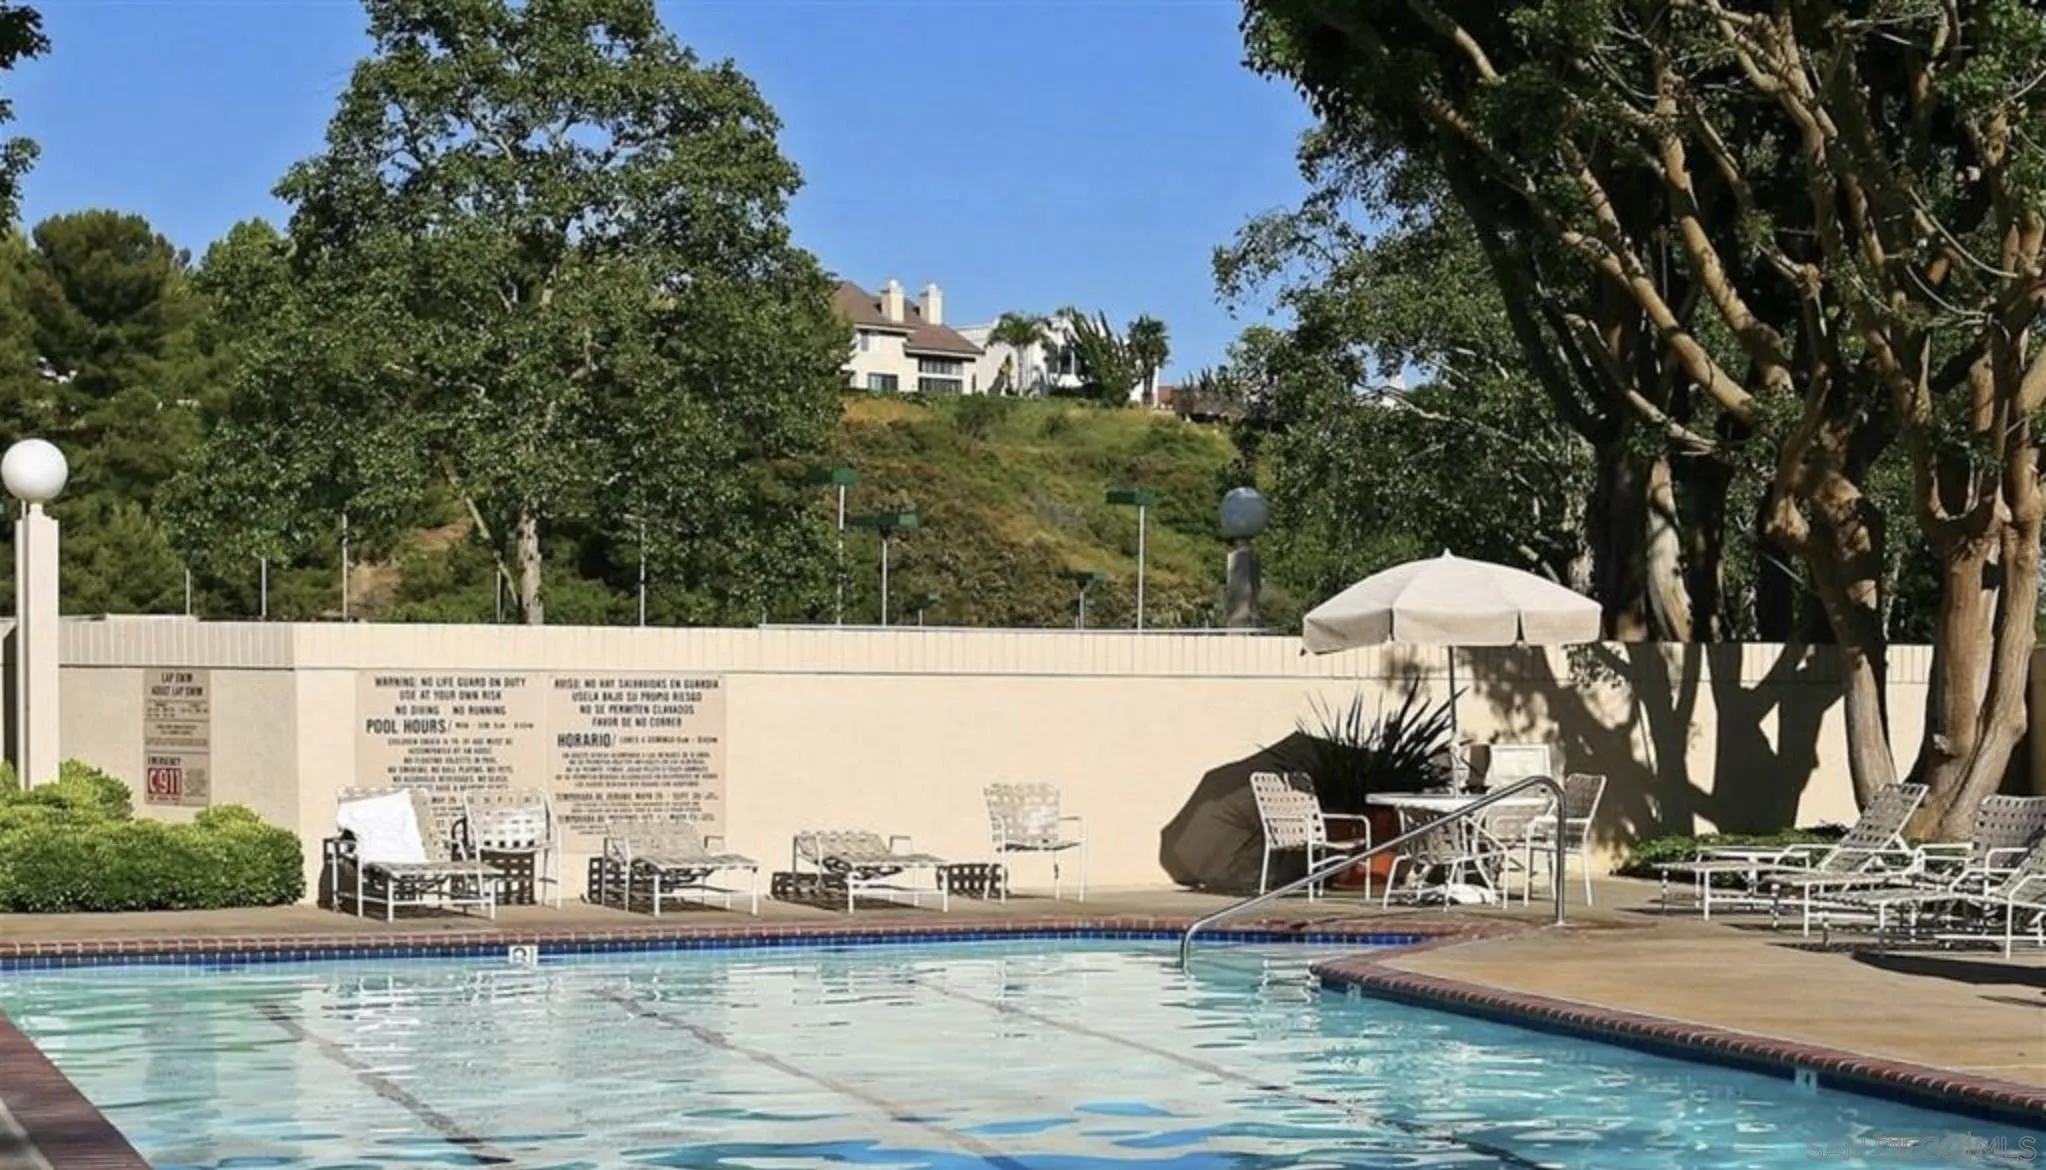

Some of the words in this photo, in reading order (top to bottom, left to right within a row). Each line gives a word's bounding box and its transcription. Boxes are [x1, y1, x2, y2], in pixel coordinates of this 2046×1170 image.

[161, 671, 174, 683] LAP
[175, 671, 193, 683] SWIM
[420, 676, 433, 688] NO
[435, 676, 453, 688] LIFE
[457, 676, 486, 688] GUARD
[488, 676, 501, 688] ON
[503, 676, 526, 688] DUTY
[583, 679, 596, 690] NO
[598, 679, 615, 690] HAY
[669, 679, 681, 690] EN
[683, 679, 719, 690] GUARDIA
[171, 686, 184, 697] LAP
[185, 686, 203, 697] SWIM
[399, 690, 415, 701] USE
[419, 690, 431, 701] AT
[433, 690, 456, 701] YOUR
[458, 690, 478, 701] OWN
[481, 690, 501, 701] RISK
[602, 691, 624, 703] BAJO
[626, 691, 638, 703] SU
[672, 691, 703, 703] RIESGO
[394, 705, 407, 716] NO
[410, 705, 440, 716] DIVING
[452, 705, 465, 716] NO
[467, 705, 507, 716] RUNNING
[579, 704, 592, 715] NO
[594, 704, 605, 715] SE
[608, 704, 650, 715] PERMITEN
[652, 704, 695, 715] CLAVADOS
[365, 718, 399, 735] POOL
[591, 717, 619, 728] FAVOR
[621, 717, 632, 728] DE
[635, 717, 647, 728] NO
[649, 717, 682, 728] CORRER
